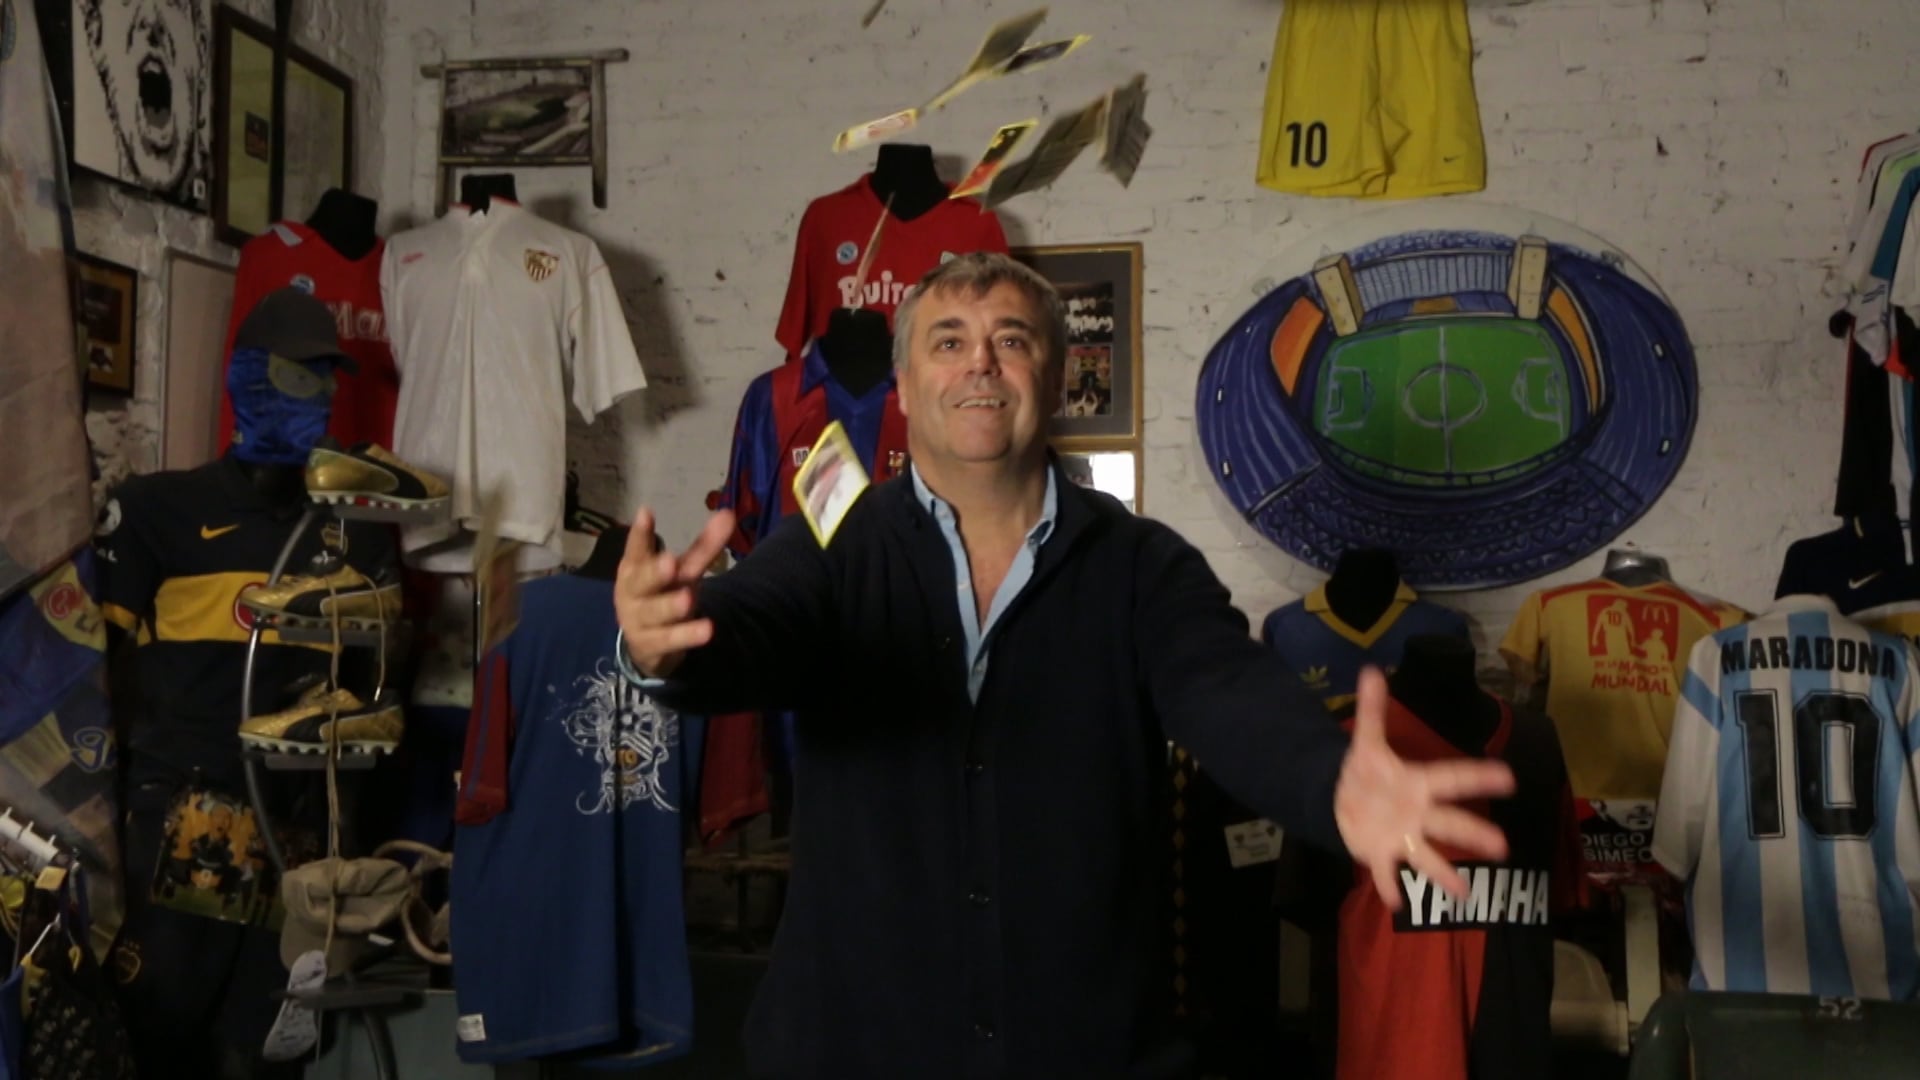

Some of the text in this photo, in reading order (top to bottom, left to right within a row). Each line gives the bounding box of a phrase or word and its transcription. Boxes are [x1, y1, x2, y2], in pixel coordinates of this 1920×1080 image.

[1286, 121, 1327, 168] 10
[1606, 609, 1621, 626] 10
[1720, 636, 1896, 681] MARADONA
[1591, 672, 1672, 697] MUNDIAL
[1733, 688, 1885, 840] 10
[1579, 832, 1646, 848] DIEGO
[1583, 846, 1654, 864] SIMEO
[1399, 865, 1549, 927] YAMAHA
[1818, 995, 1863, 1021] 52
